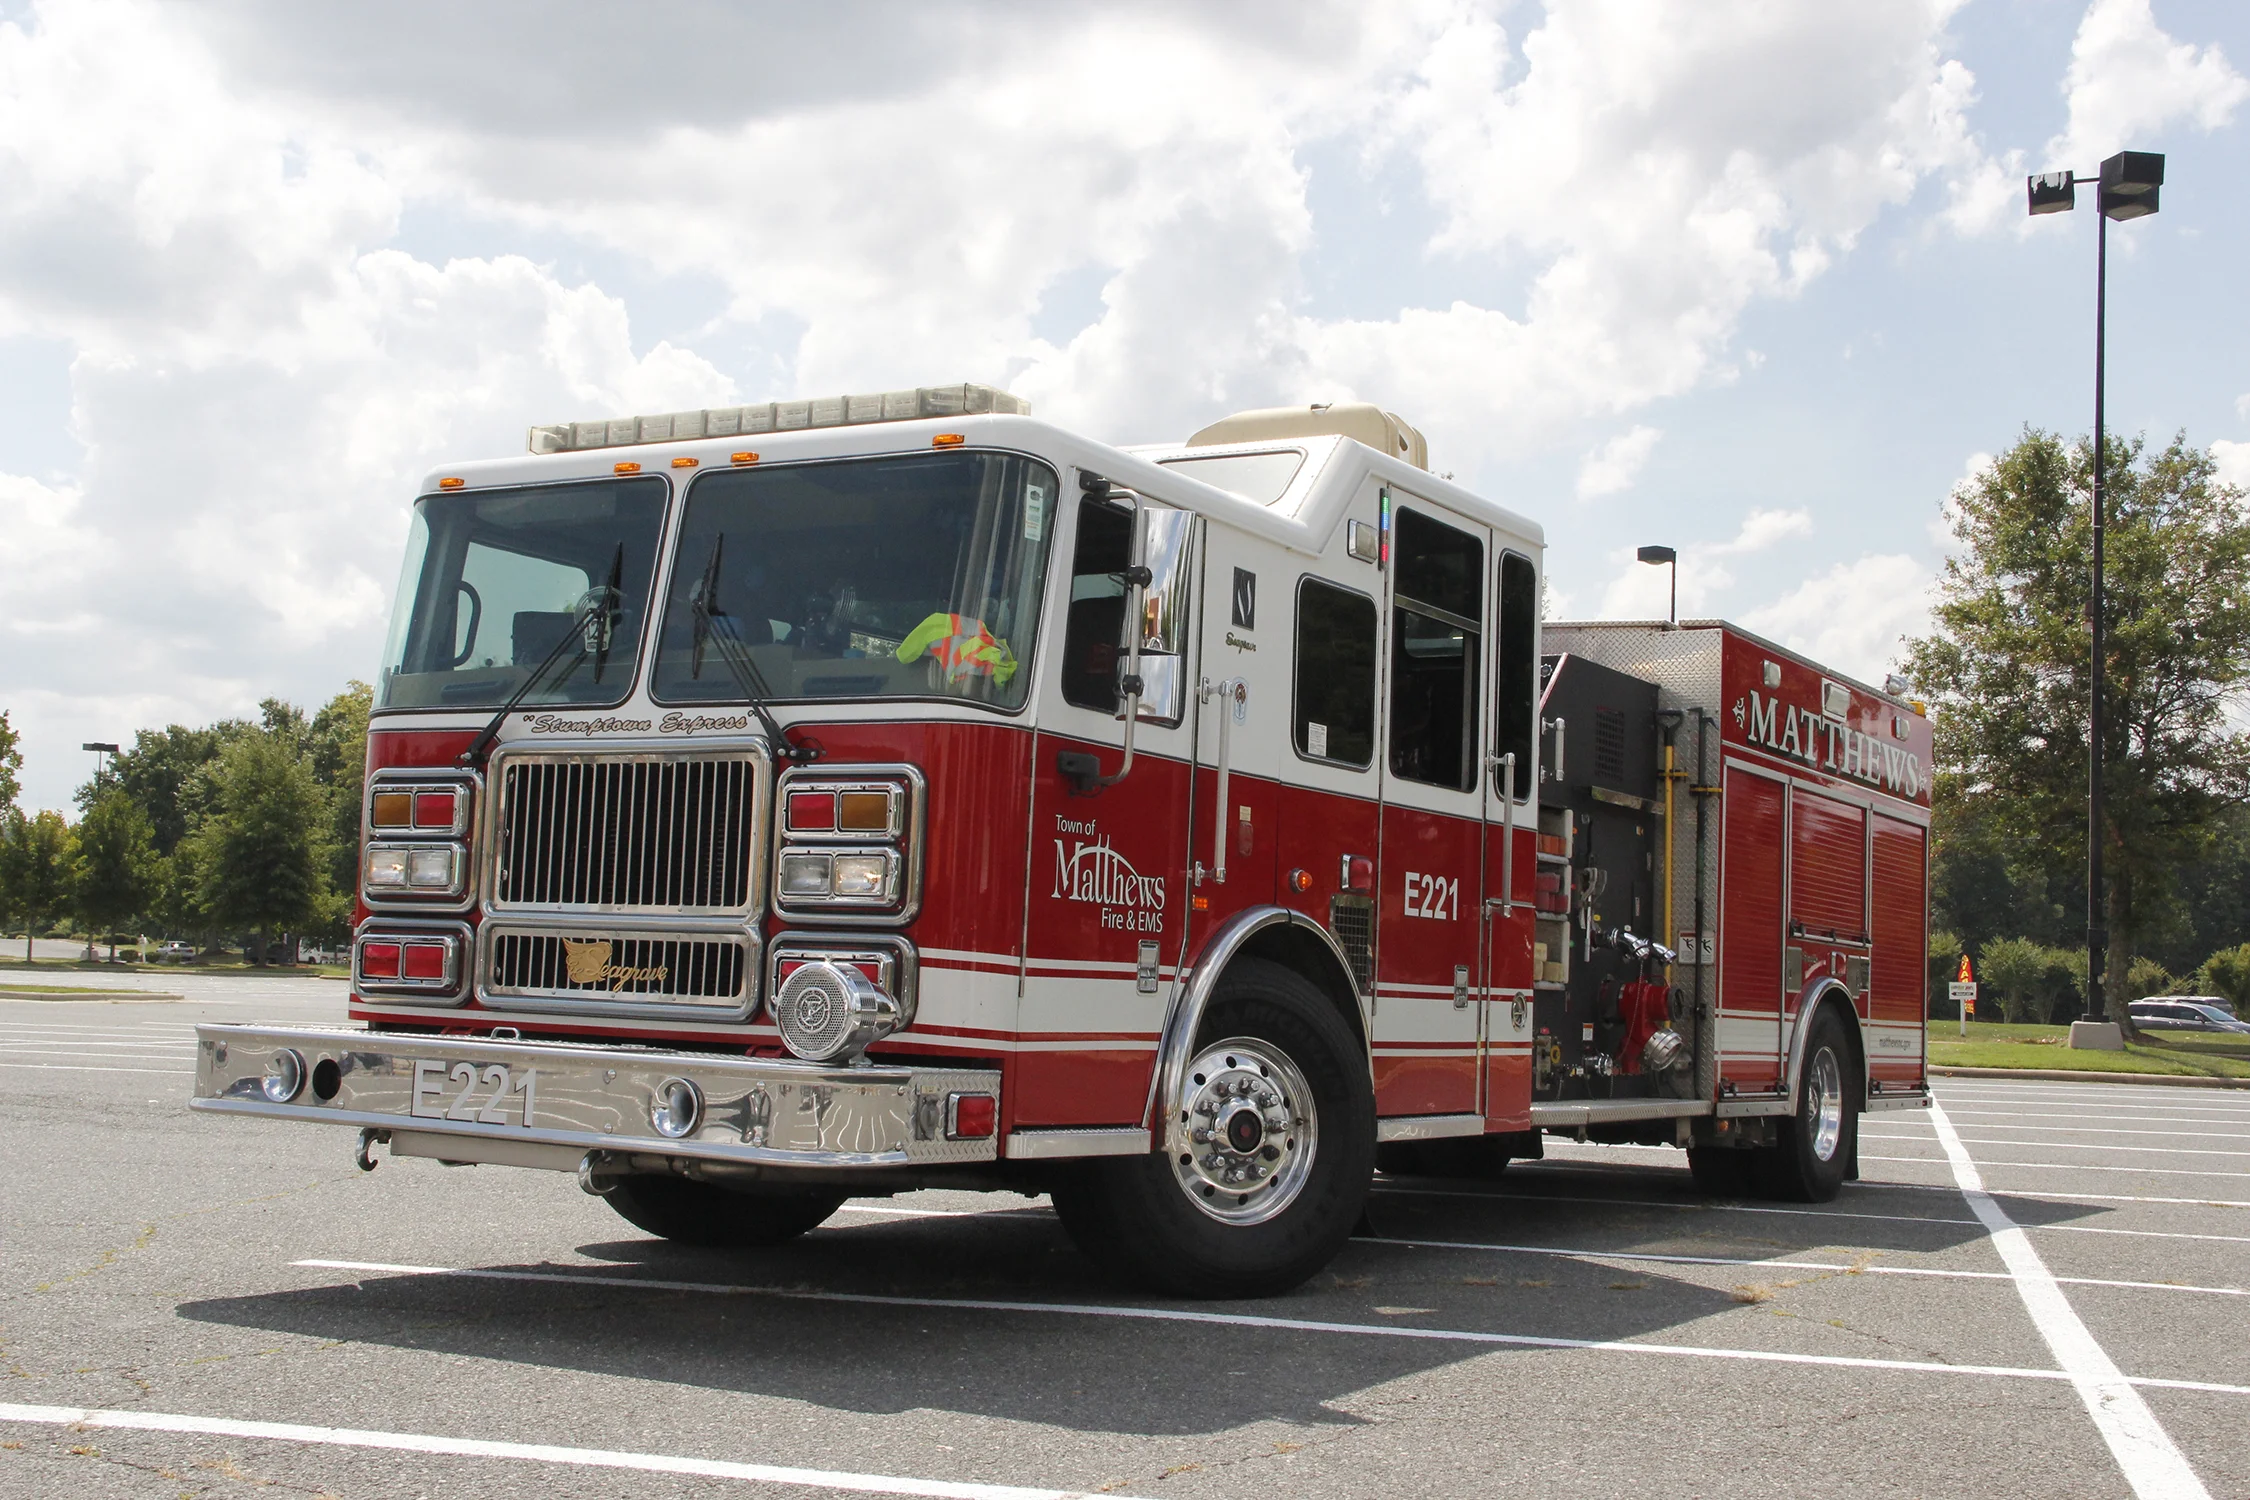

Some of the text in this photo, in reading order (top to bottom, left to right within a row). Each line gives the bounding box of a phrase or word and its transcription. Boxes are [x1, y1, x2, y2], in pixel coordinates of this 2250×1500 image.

[1747, 689, 1918, 798] MATTHEWS
[1055, 814, 1097, 836] Town of
[1051, 832, 1166, 911] Matthews
[1404, 871, 1459, 921] E221
[1101, 907, 1163, 933] Fire & EMS
[586, 943, 669, 993] Seagrave
[410, 1059, 537, 1128] E221
